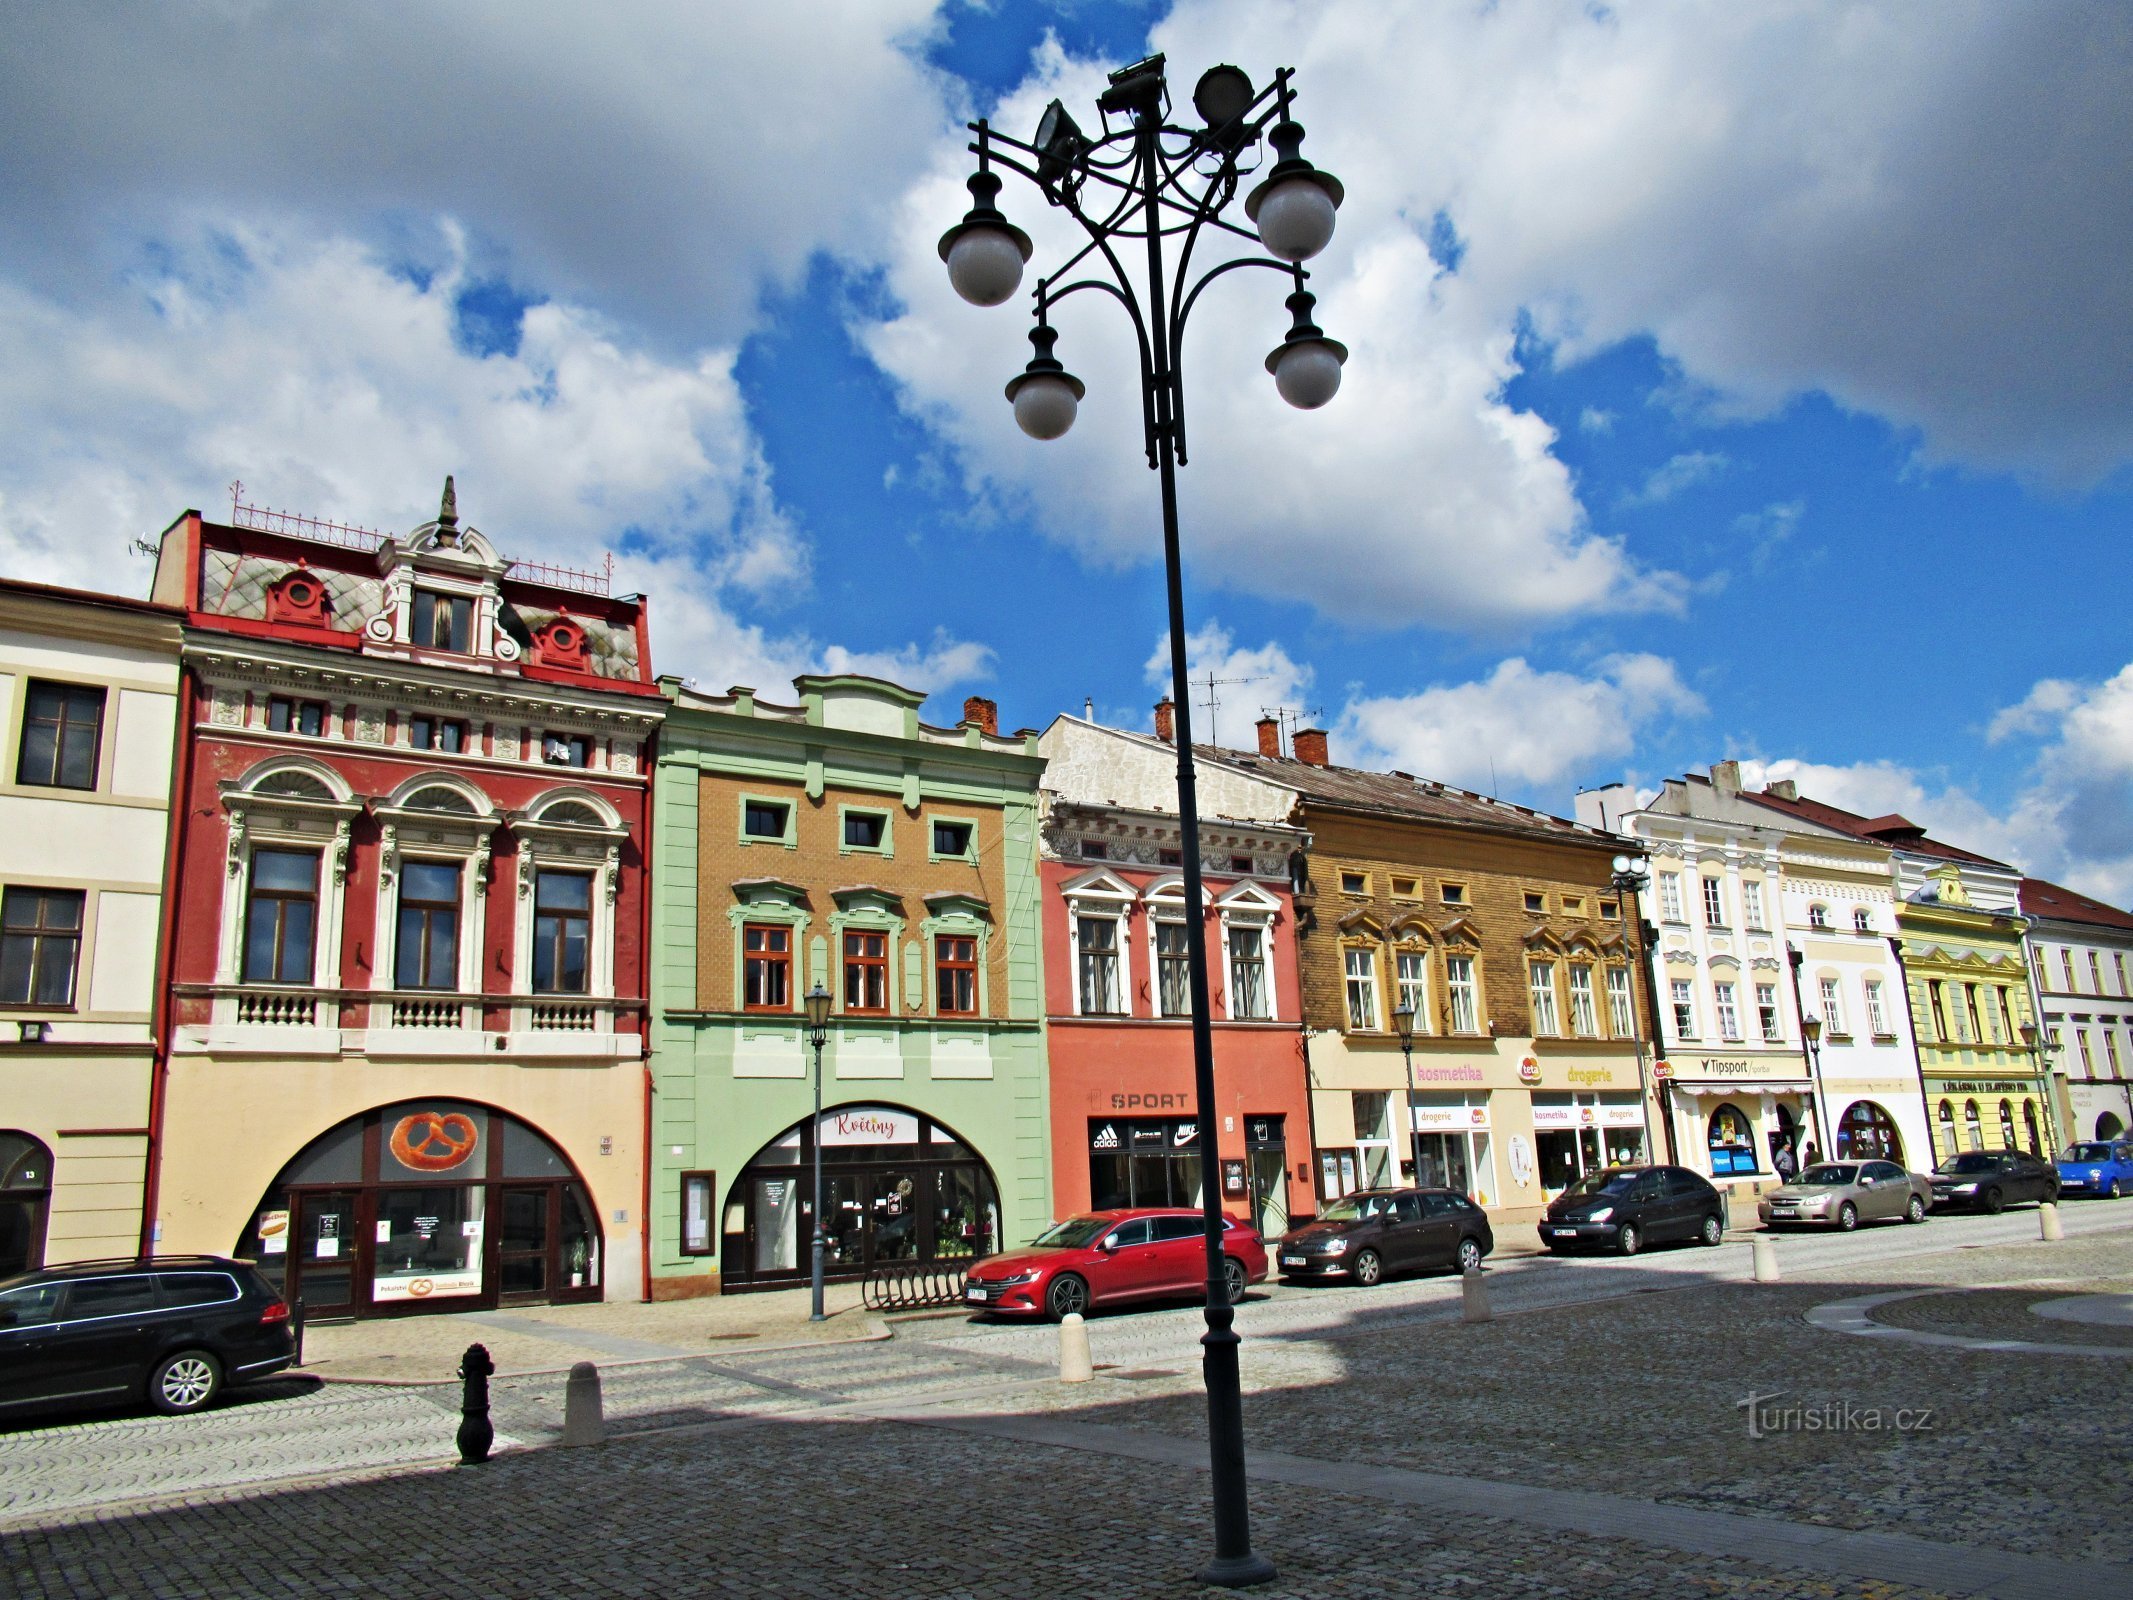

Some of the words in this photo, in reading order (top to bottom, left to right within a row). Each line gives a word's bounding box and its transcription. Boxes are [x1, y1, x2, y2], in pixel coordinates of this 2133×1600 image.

[1416, 1064, 1483, 1081] kosmetika
[1523, 1064, 1539, 1074] teta
[1656, 1066, 1672, 1075] teta
[1711, 1060, 1747, 1075] Tipsport
[1568, 1066, 1612, 1085] drogerie
[1111, 1093, 1188, 1109] SPORT
[1421, 1112, 1451, 1123] drogerie
[1534, 1110, 1568, 1119] kosmetika
[1609, 1109, 1634, 1120] drogerie
[834, 1113, 897, 1139] Květiny
[1178, 1124, 1197, 1136] NIKE
[25, 1171, 35, 1179] 13
